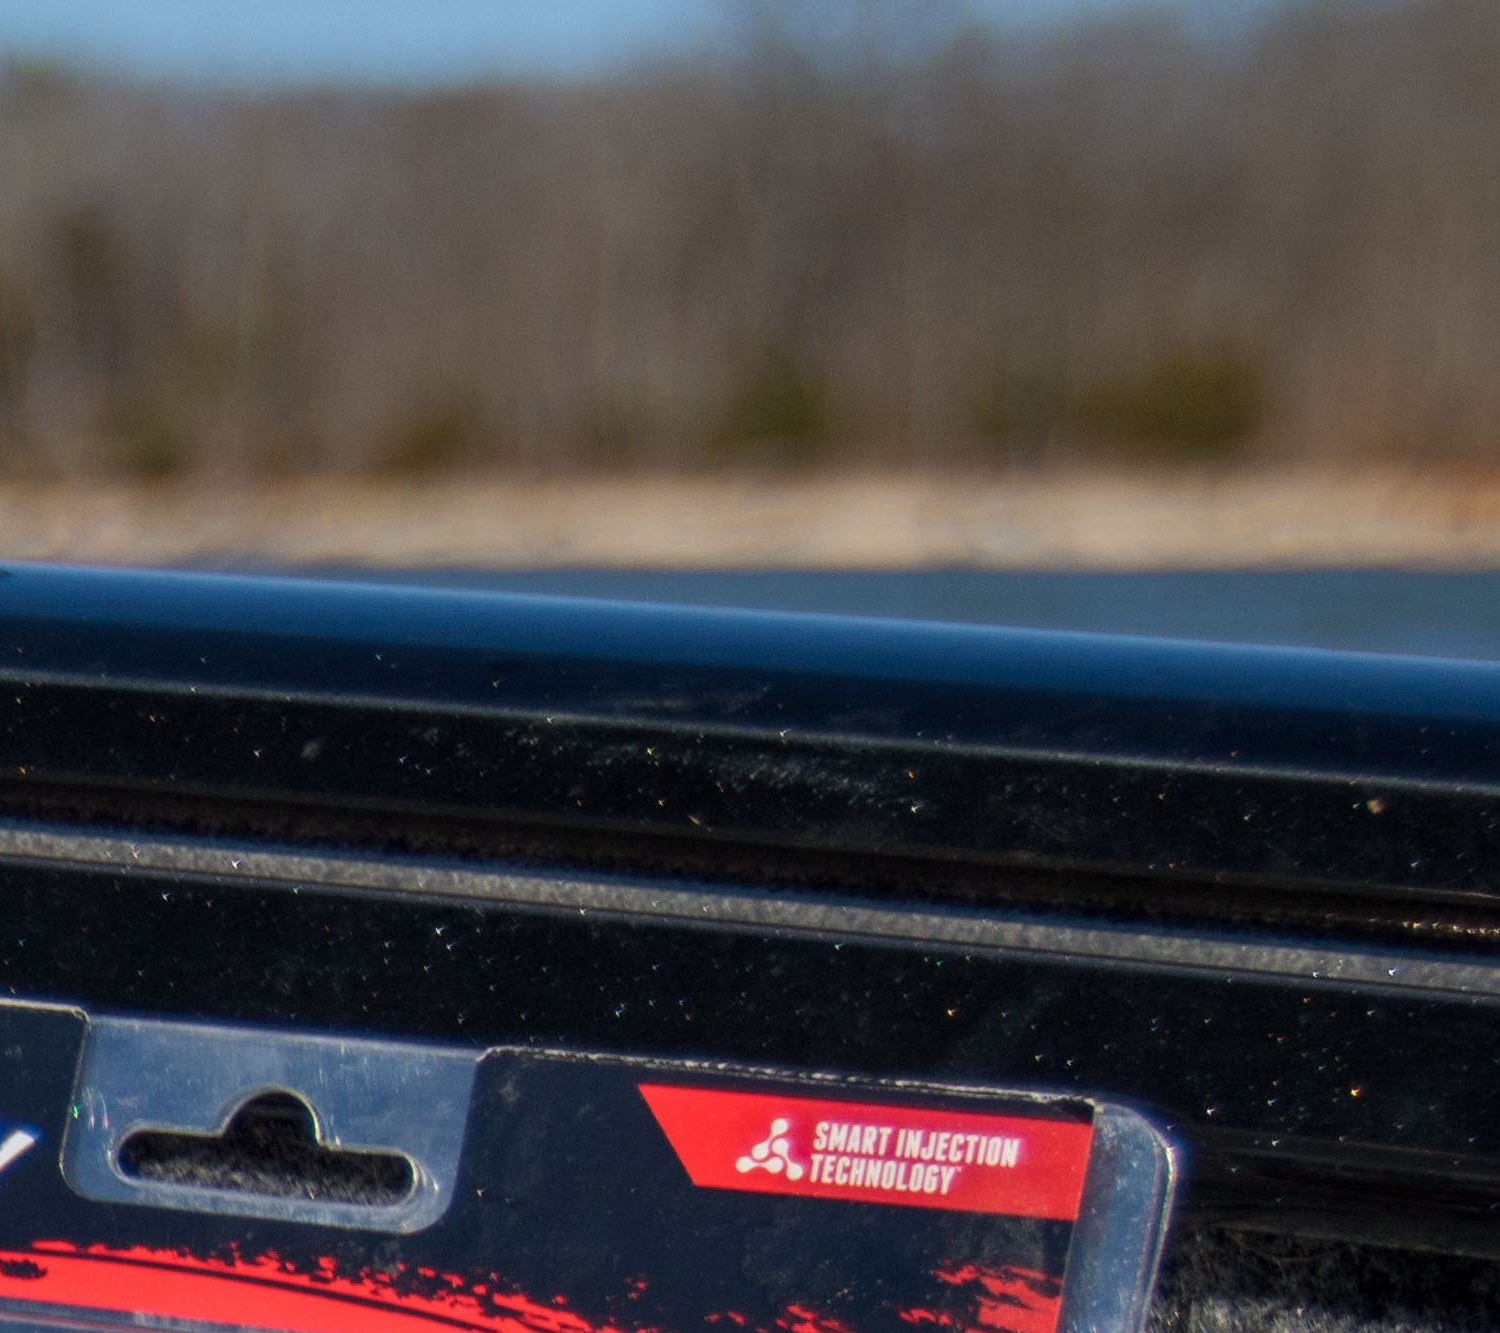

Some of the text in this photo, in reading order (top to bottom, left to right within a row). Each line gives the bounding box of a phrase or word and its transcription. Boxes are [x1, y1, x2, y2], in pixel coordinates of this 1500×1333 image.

[813, 1121, 1021, 1168] SMART INJECTION
[810, 1153, 956, 1196] TECHNOLOGY
